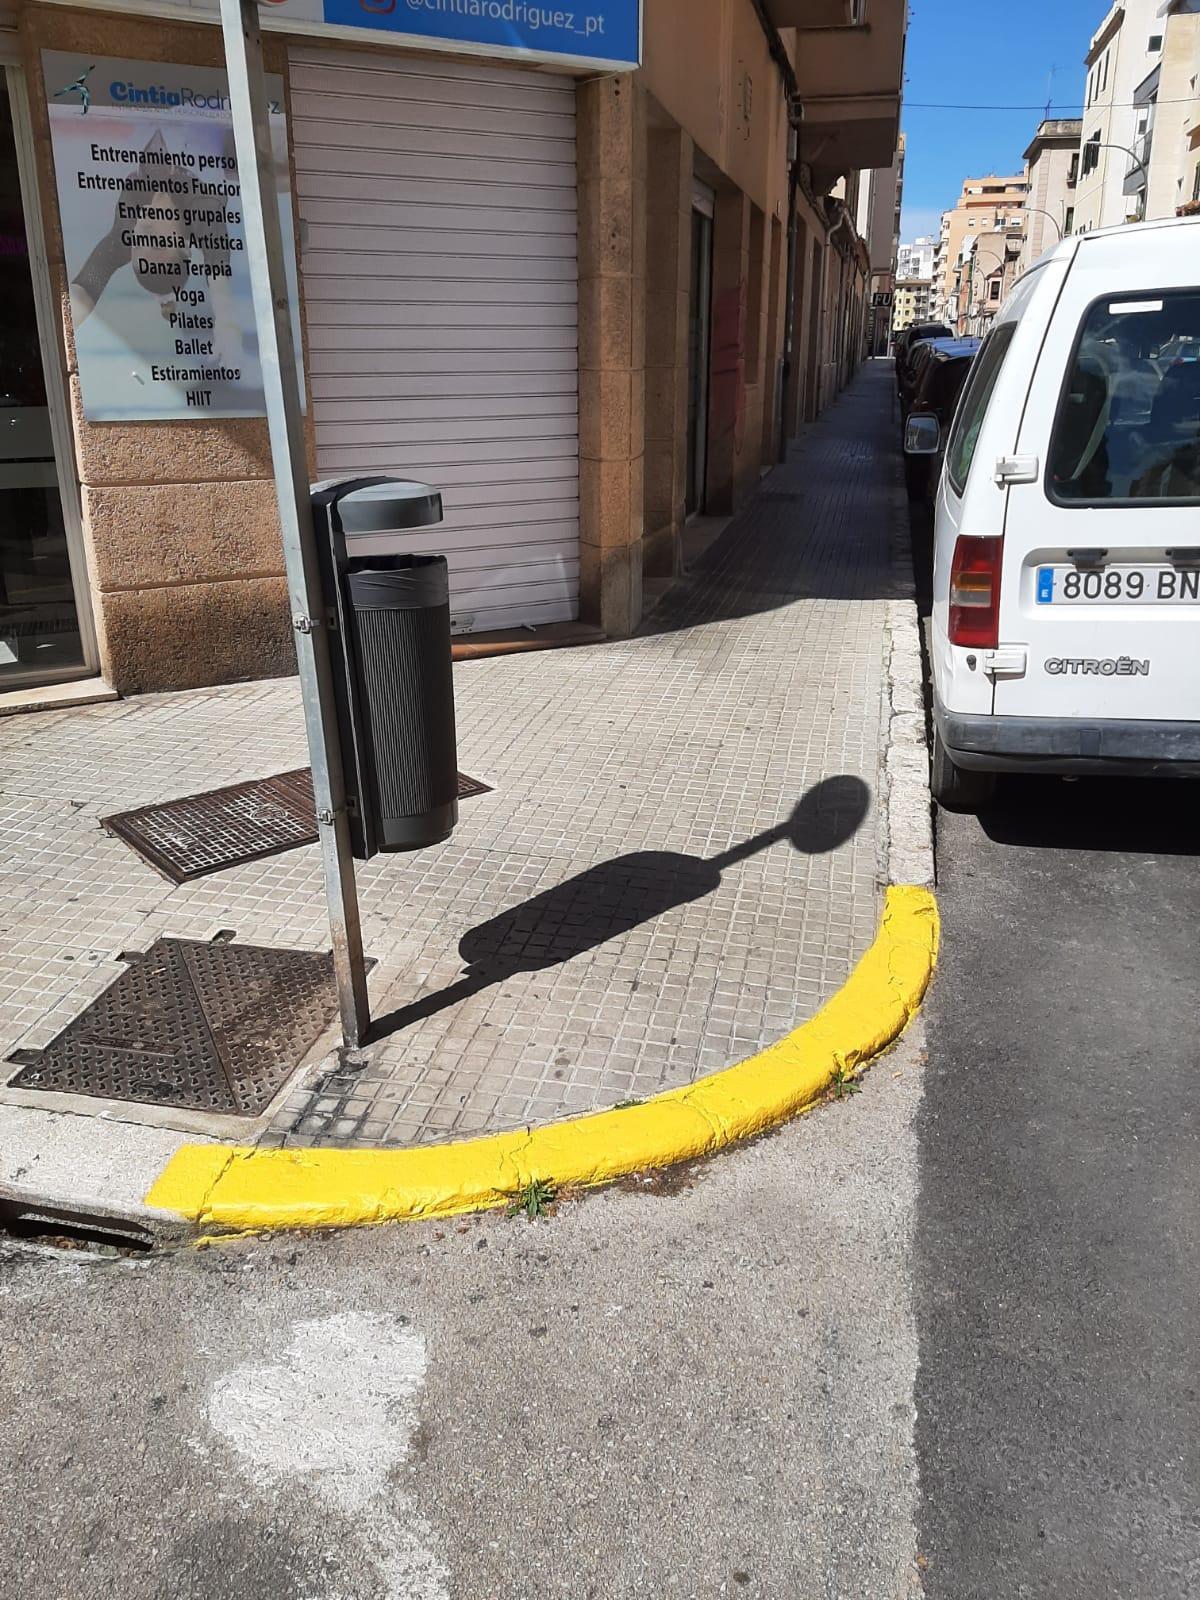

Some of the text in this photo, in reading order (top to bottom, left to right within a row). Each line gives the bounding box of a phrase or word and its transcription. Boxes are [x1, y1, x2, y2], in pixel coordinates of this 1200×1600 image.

[91, 144, 238, 172] Entrenamiento perso
[77, 172, 189, 194] Entrenamientos
[118, 202, 241, 226] Entrenos grupales
[121, 229, 244, 251] Gimnasia Artística
[139, 258, 233, 279] Danza Terapia
[172, 286, 205, 306] Yoga
[169, 313, 214, 329] Pilates
[175, 340, 213, 355] Ballet
[151, 365, 241, 382] Estiramientos
[186, 391, 212, 407] HIIT
[1041, 589, 1049, 598] E
[1063, 570, 1200, 600] 8089 BN
[1044, 656, 1150, 676] CITROËN
